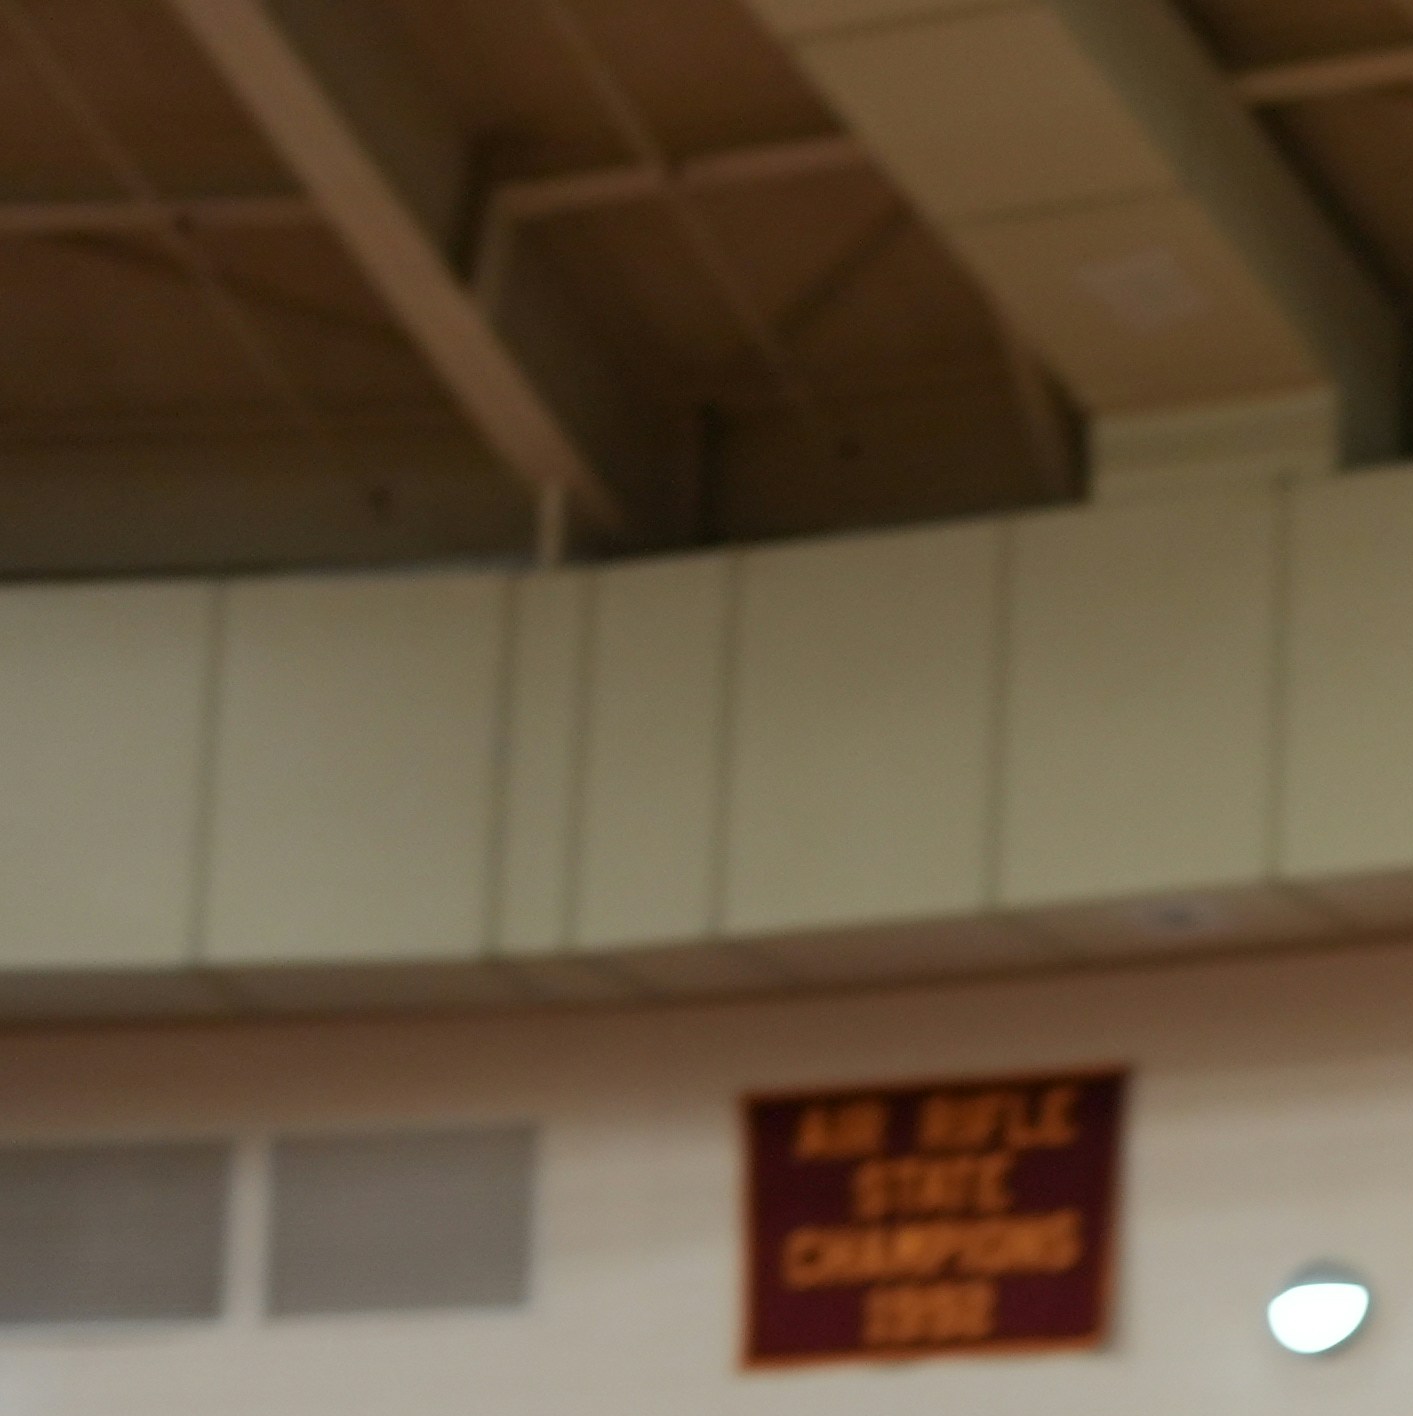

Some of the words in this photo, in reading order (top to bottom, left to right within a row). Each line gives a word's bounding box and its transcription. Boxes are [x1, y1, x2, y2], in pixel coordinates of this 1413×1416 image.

[796, 1101, 884, 1159] AIR
[919, 1087, 1078, 1151] RIFLE
[855, 1152, 1011, 1215] STATE
[784, 1210, 1082, 1288] CHAMPIONS
